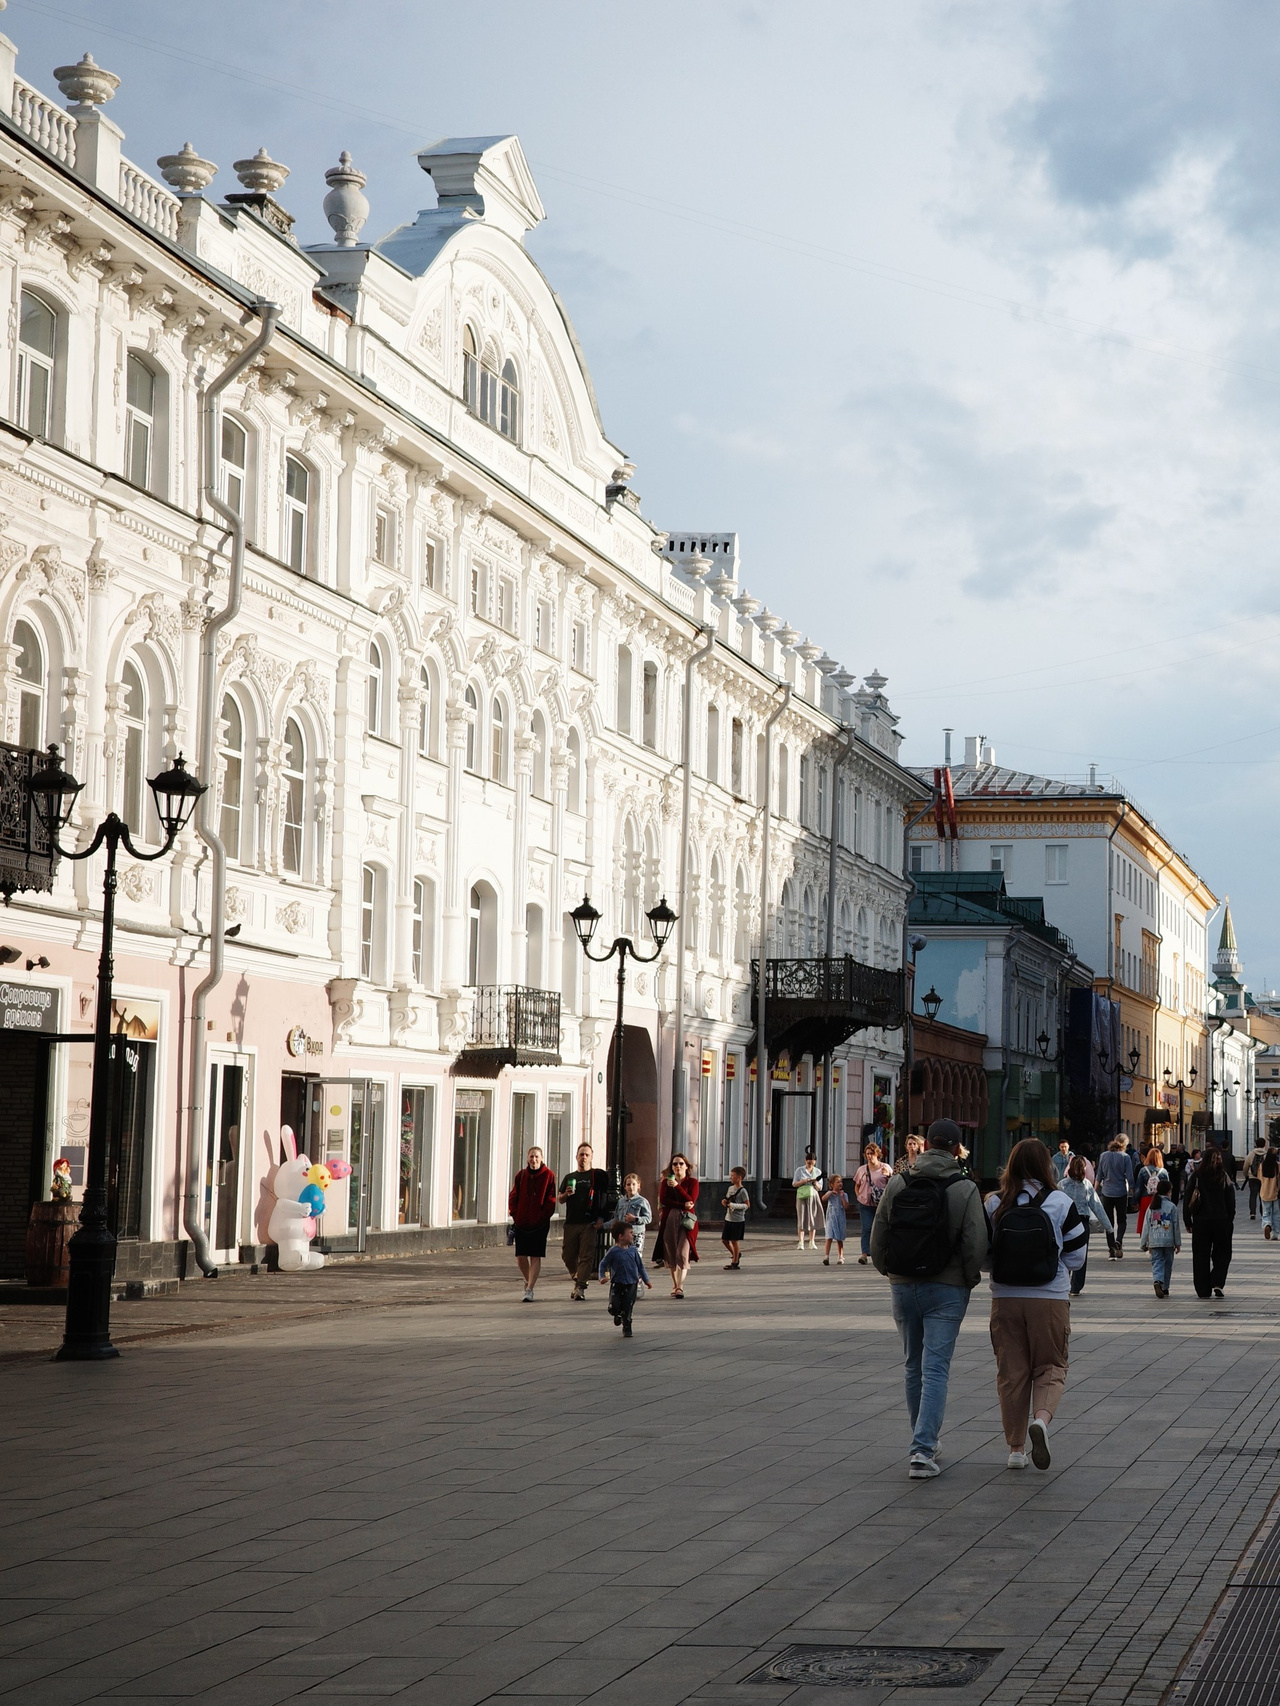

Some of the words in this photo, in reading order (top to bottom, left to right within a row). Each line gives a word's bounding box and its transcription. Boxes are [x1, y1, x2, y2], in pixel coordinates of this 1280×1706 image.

[0, 983, 52, 1011] Сокровища
[3, 1008, 43, 1029] дракона
[306, 1036, 324, 1054] Вход
